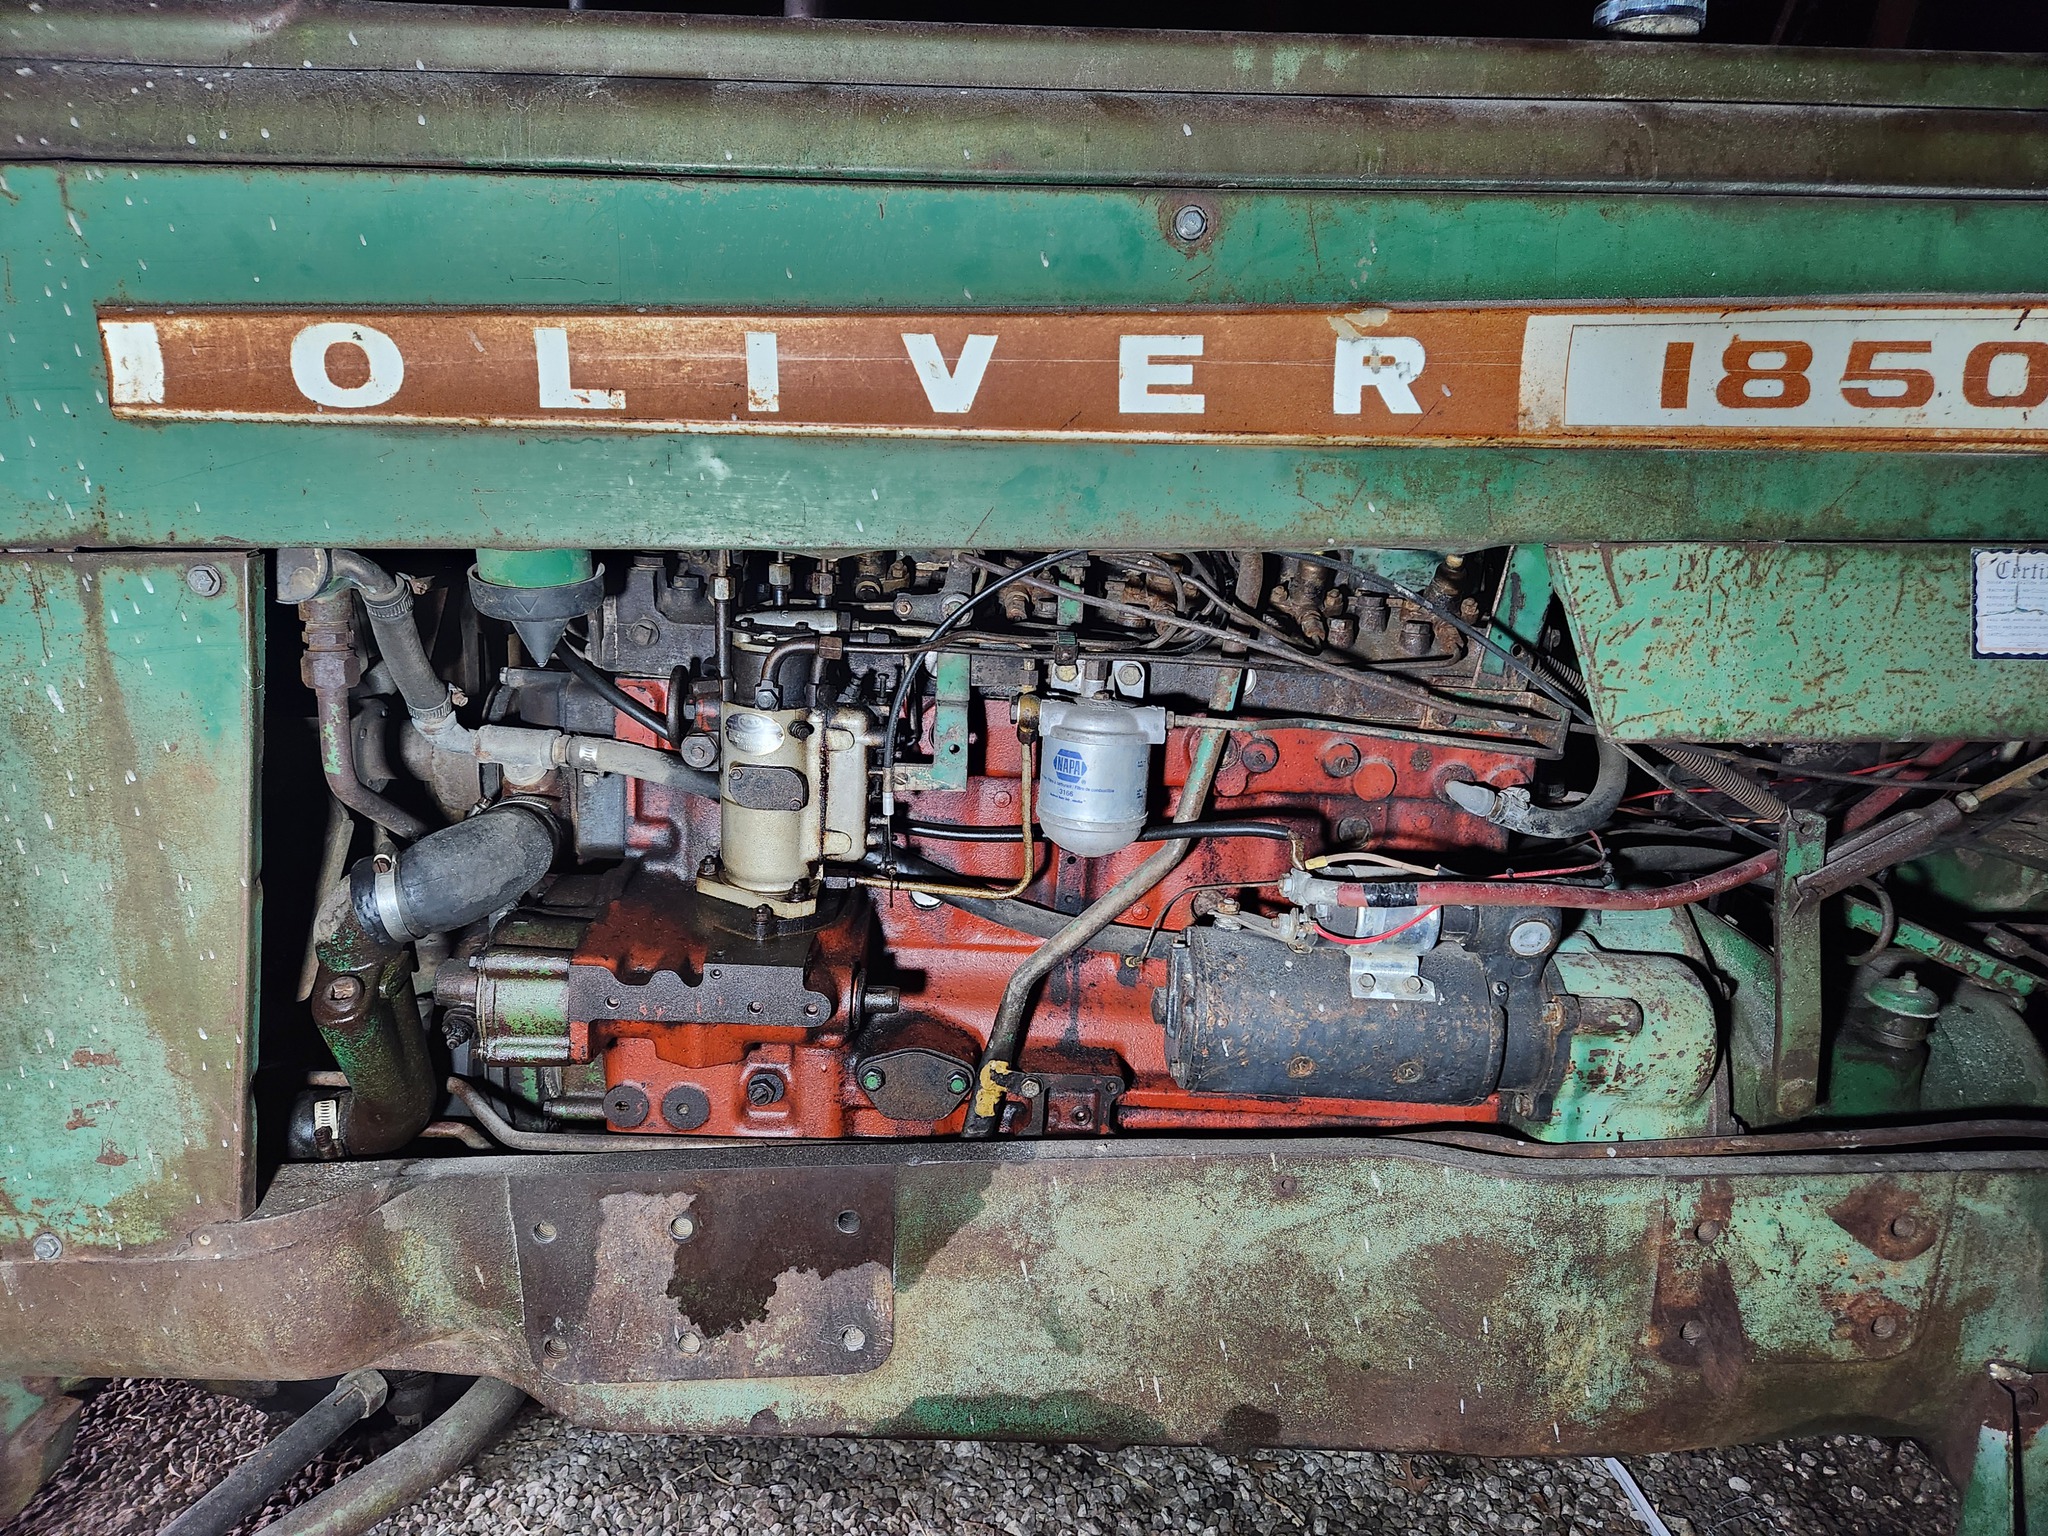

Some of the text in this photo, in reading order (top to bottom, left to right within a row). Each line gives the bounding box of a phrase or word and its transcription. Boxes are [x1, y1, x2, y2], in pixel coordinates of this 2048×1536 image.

[289, 321, 1426, 416] OLIVER
[1659, 340, 2048, 409] 1850
[1057, 756, 1081, 776] NAPA
